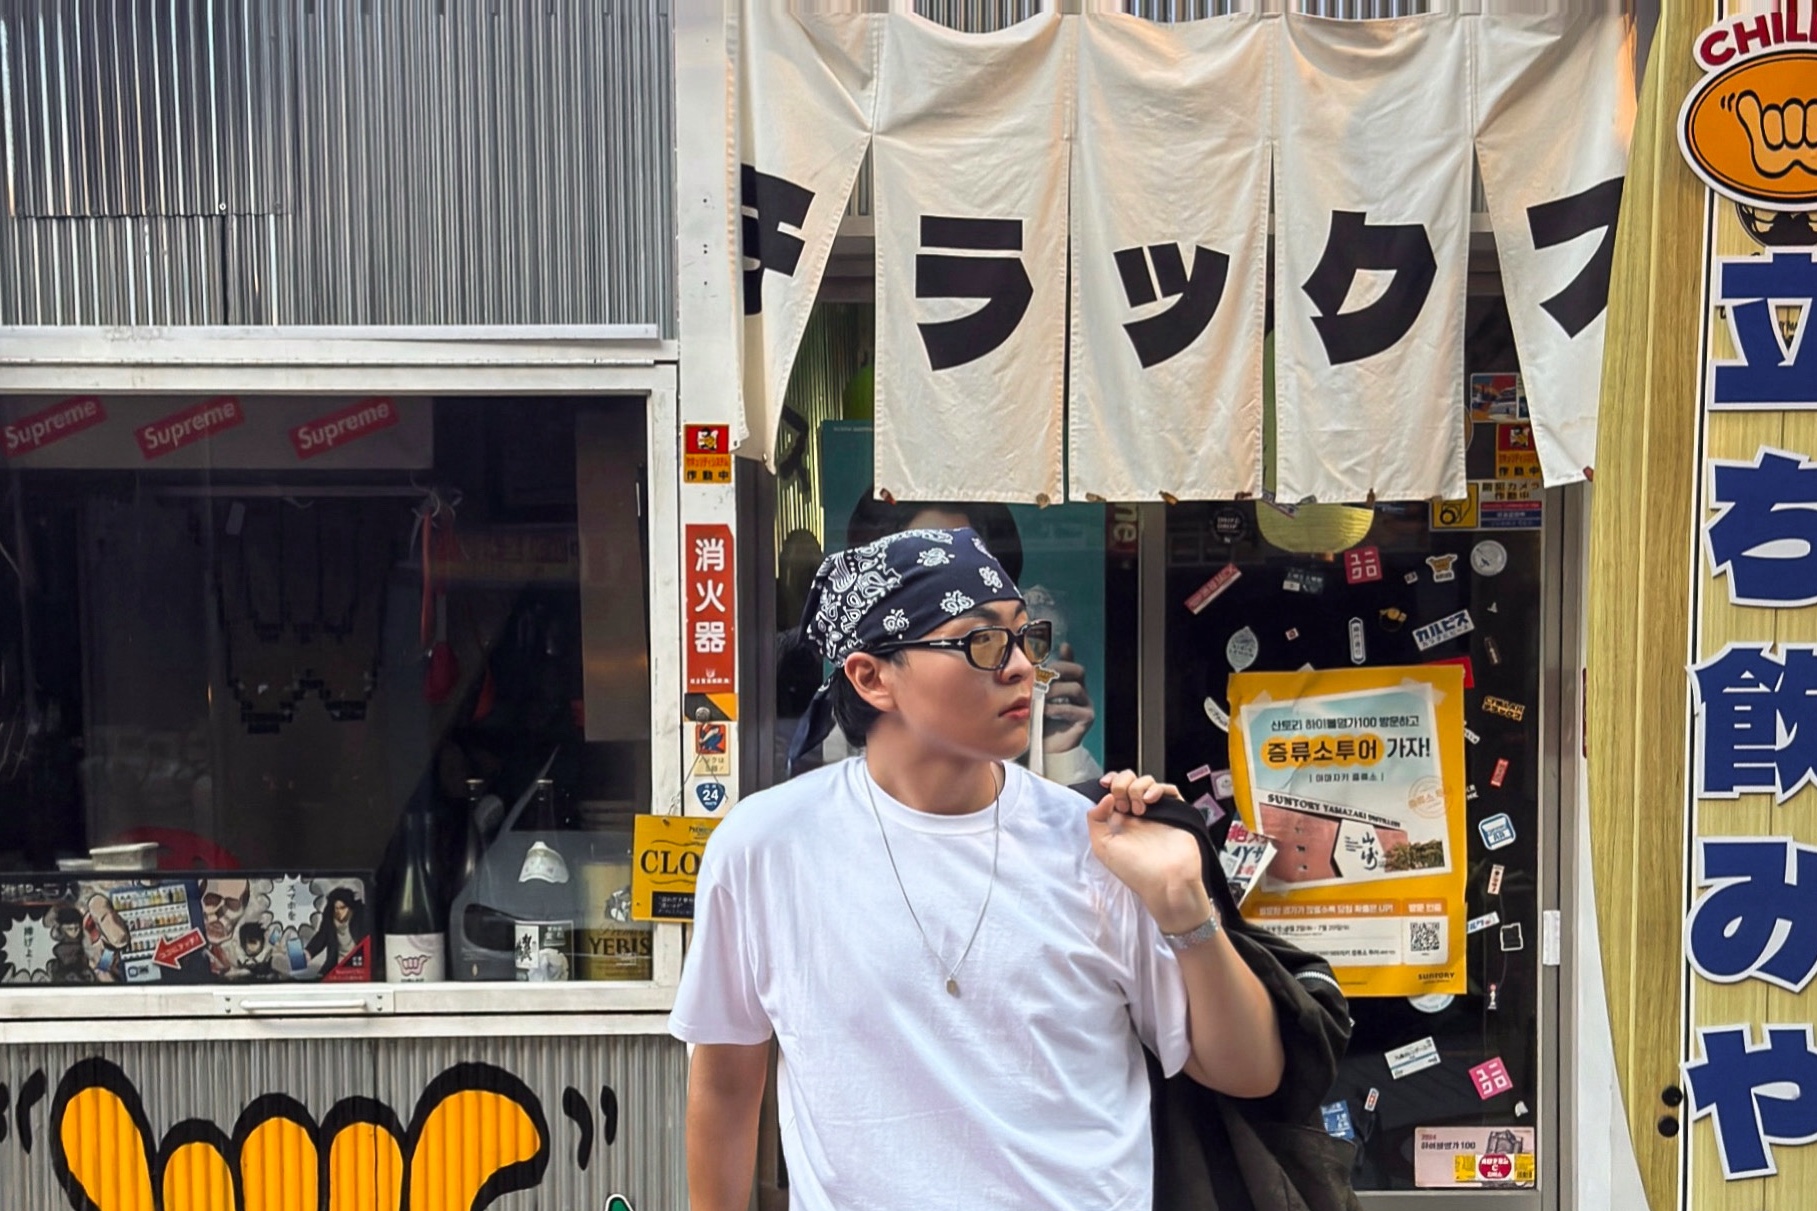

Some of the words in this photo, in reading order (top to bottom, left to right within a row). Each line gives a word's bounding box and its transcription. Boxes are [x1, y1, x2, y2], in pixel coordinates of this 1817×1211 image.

[1700, 9, 1817, 66] CHIL
[4, 398, 97, 450] Supreme
[143, 400, 236, 450] Supreme
[298, 401, 390, 450] Supreme
[695, 538, 726, 654] 消火器
[1415, 612, 1469, 642] カルピス
[1267, 739, 1377, 763] 증류소투어
[1387, 737, 1430, 758] 가자!
[702, 789, 719, 801] 24
[1268, 793, 1320, 811] SUNTORY
